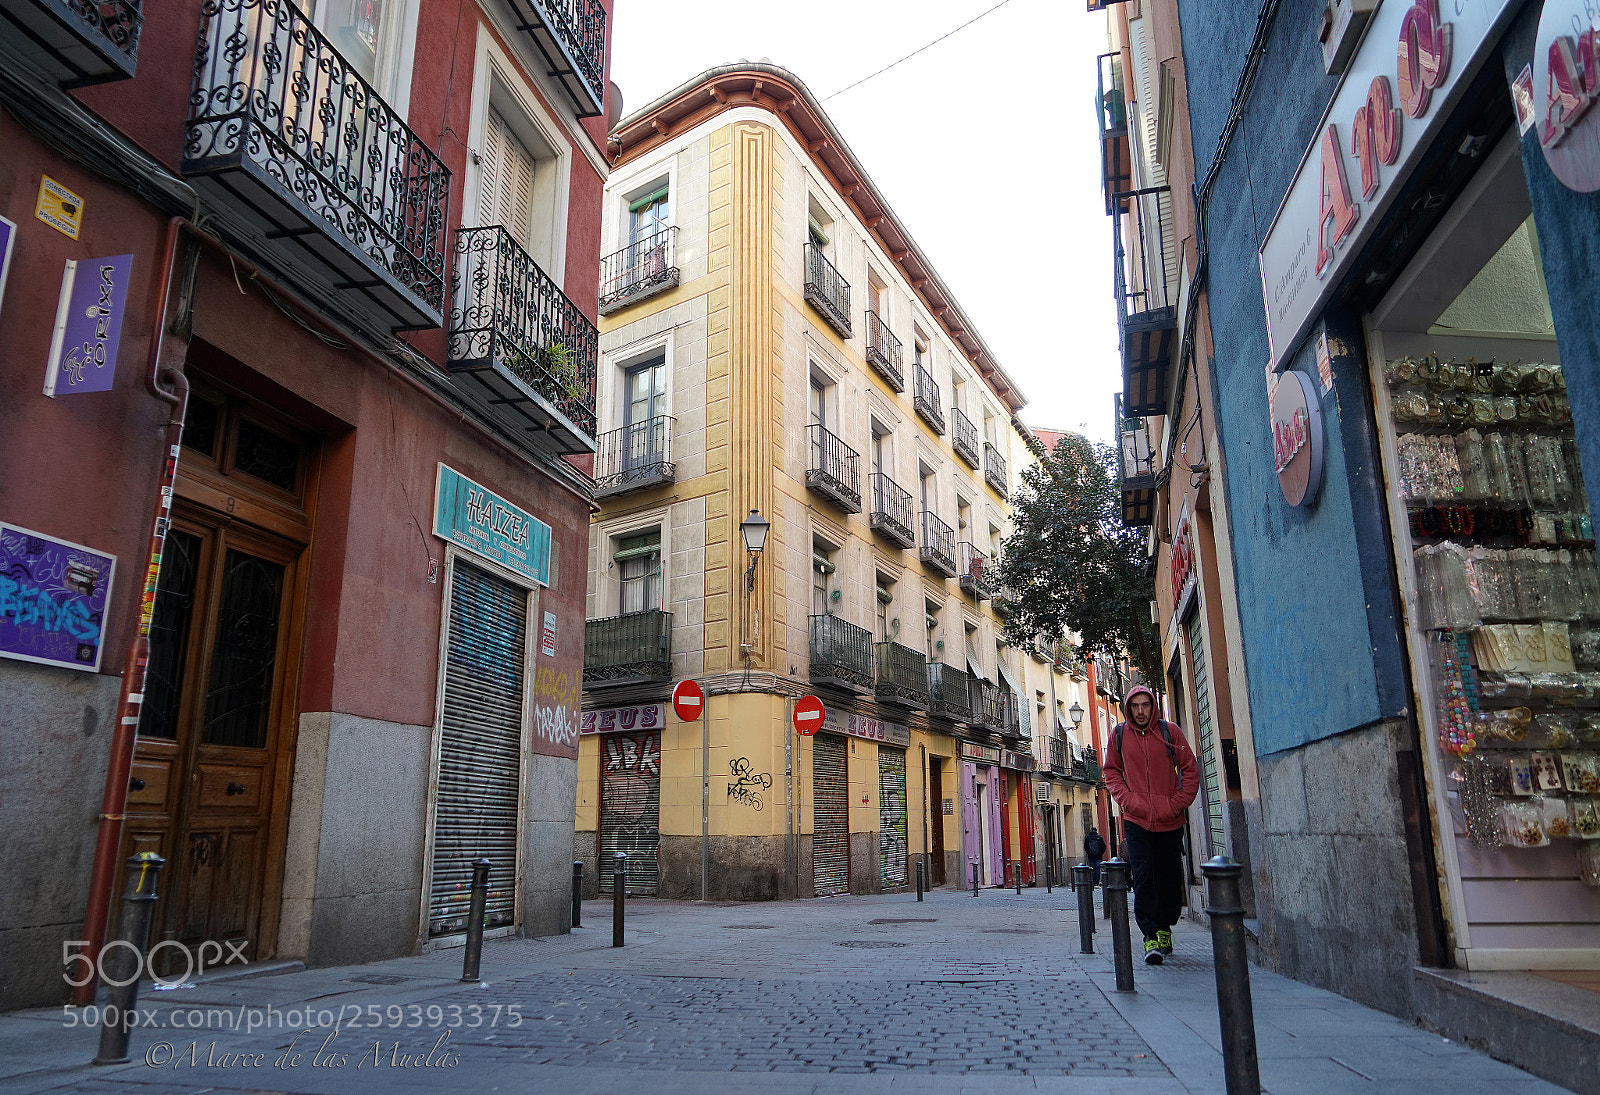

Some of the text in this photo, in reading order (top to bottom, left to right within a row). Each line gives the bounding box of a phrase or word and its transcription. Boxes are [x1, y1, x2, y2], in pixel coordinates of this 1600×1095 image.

[38, 210, 76, 236] PROSEGUR
[1280, 241, 1306, 289] Amparo
[225, 497, 235, 513] 9
[467, 488, 529, 550] HAIZEA
[581, 705, 658, 733] ZEUS
[848, 714, 885, 740] ZEUS
